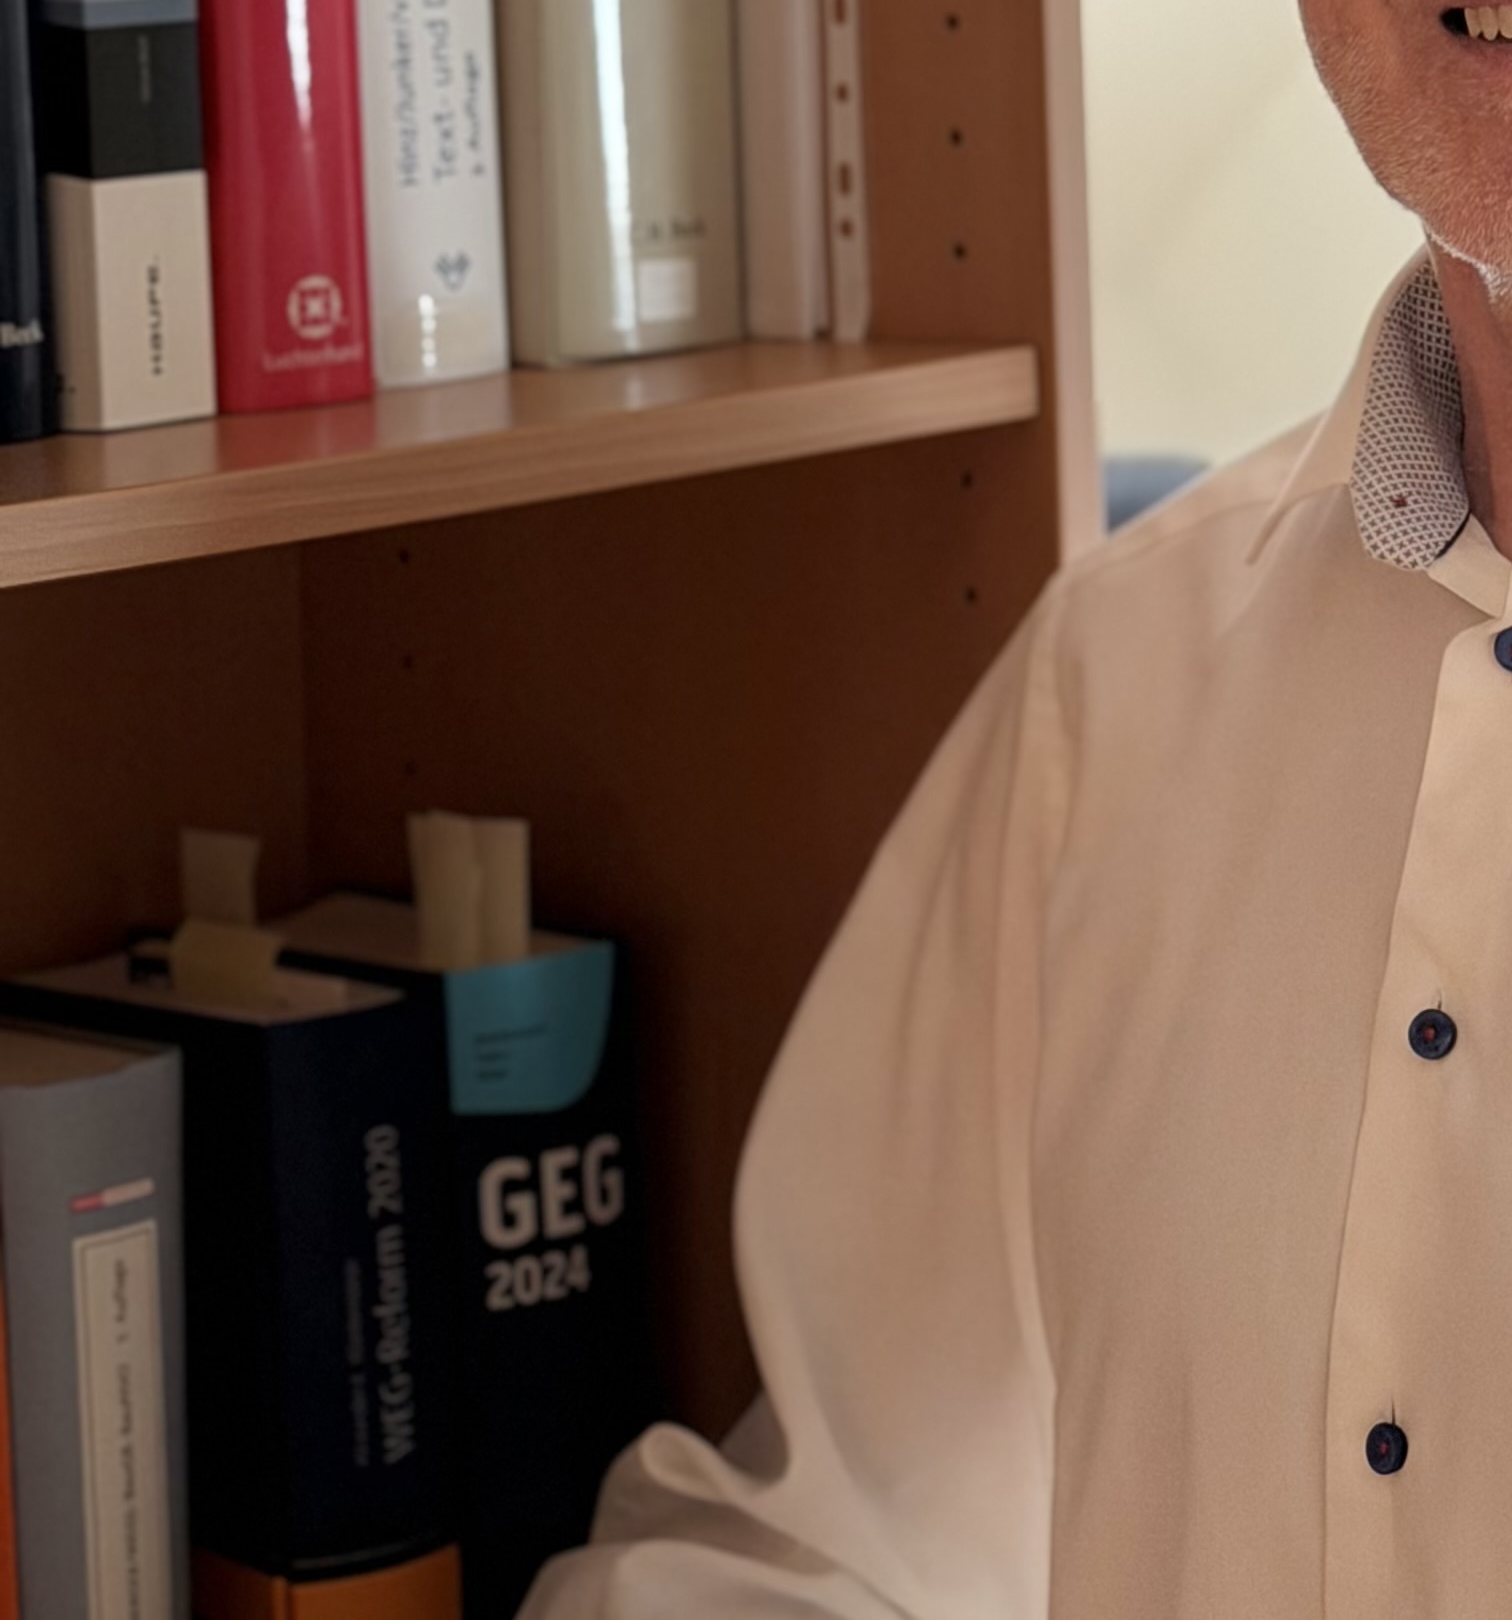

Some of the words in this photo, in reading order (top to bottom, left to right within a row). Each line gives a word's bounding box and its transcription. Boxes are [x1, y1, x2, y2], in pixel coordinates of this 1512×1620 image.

[424, 18, 452, 87] und
[364, 1123, 404, 1220] 2020
[477, 1133, 625, 1250] GEG
[484, 1243, 591, 1312] 2024
